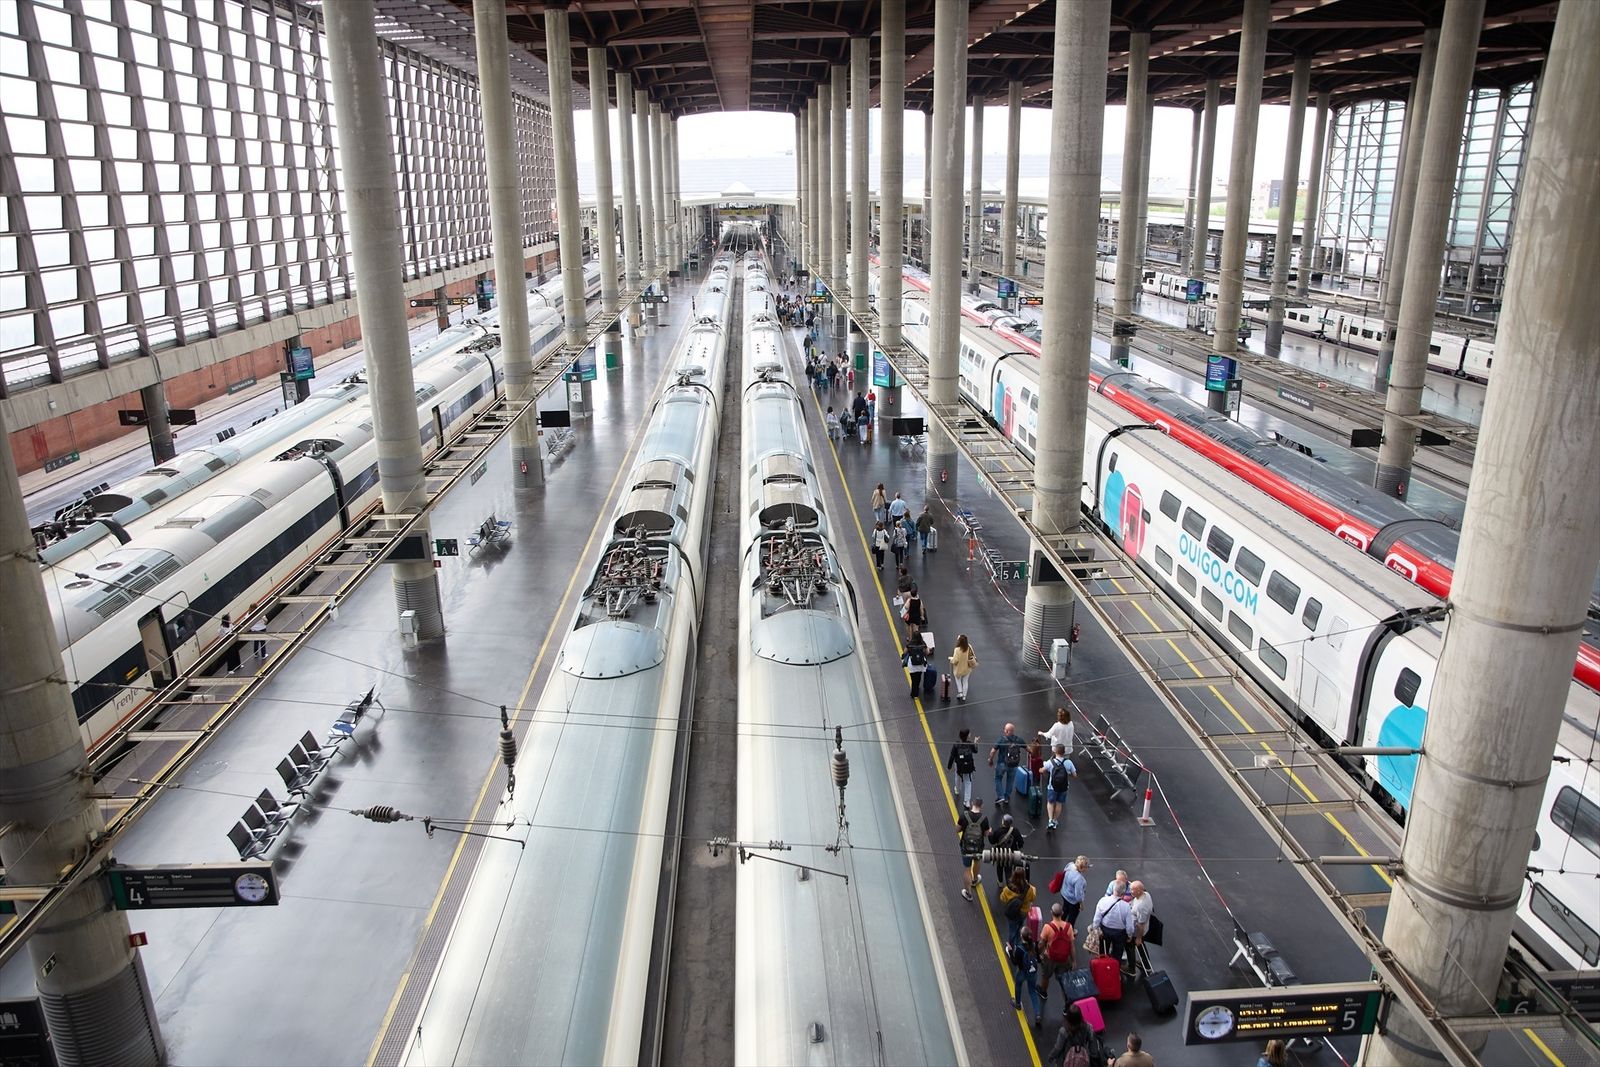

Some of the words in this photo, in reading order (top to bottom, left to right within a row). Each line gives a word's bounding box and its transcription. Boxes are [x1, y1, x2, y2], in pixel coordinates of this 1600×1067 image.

[441, 547, 448, 555] A
[452, 547, 458, 555] 4
[1003, 570, 1009, 580] 5
[1013, 570, 1020, 579] A
[1179, 533, 1258, 616] OUIGO.COM
[116, 688, 139, 710] renfe
[130, 888, 144, 905] 4
[1342, 1010, 1357, 1031] 5
